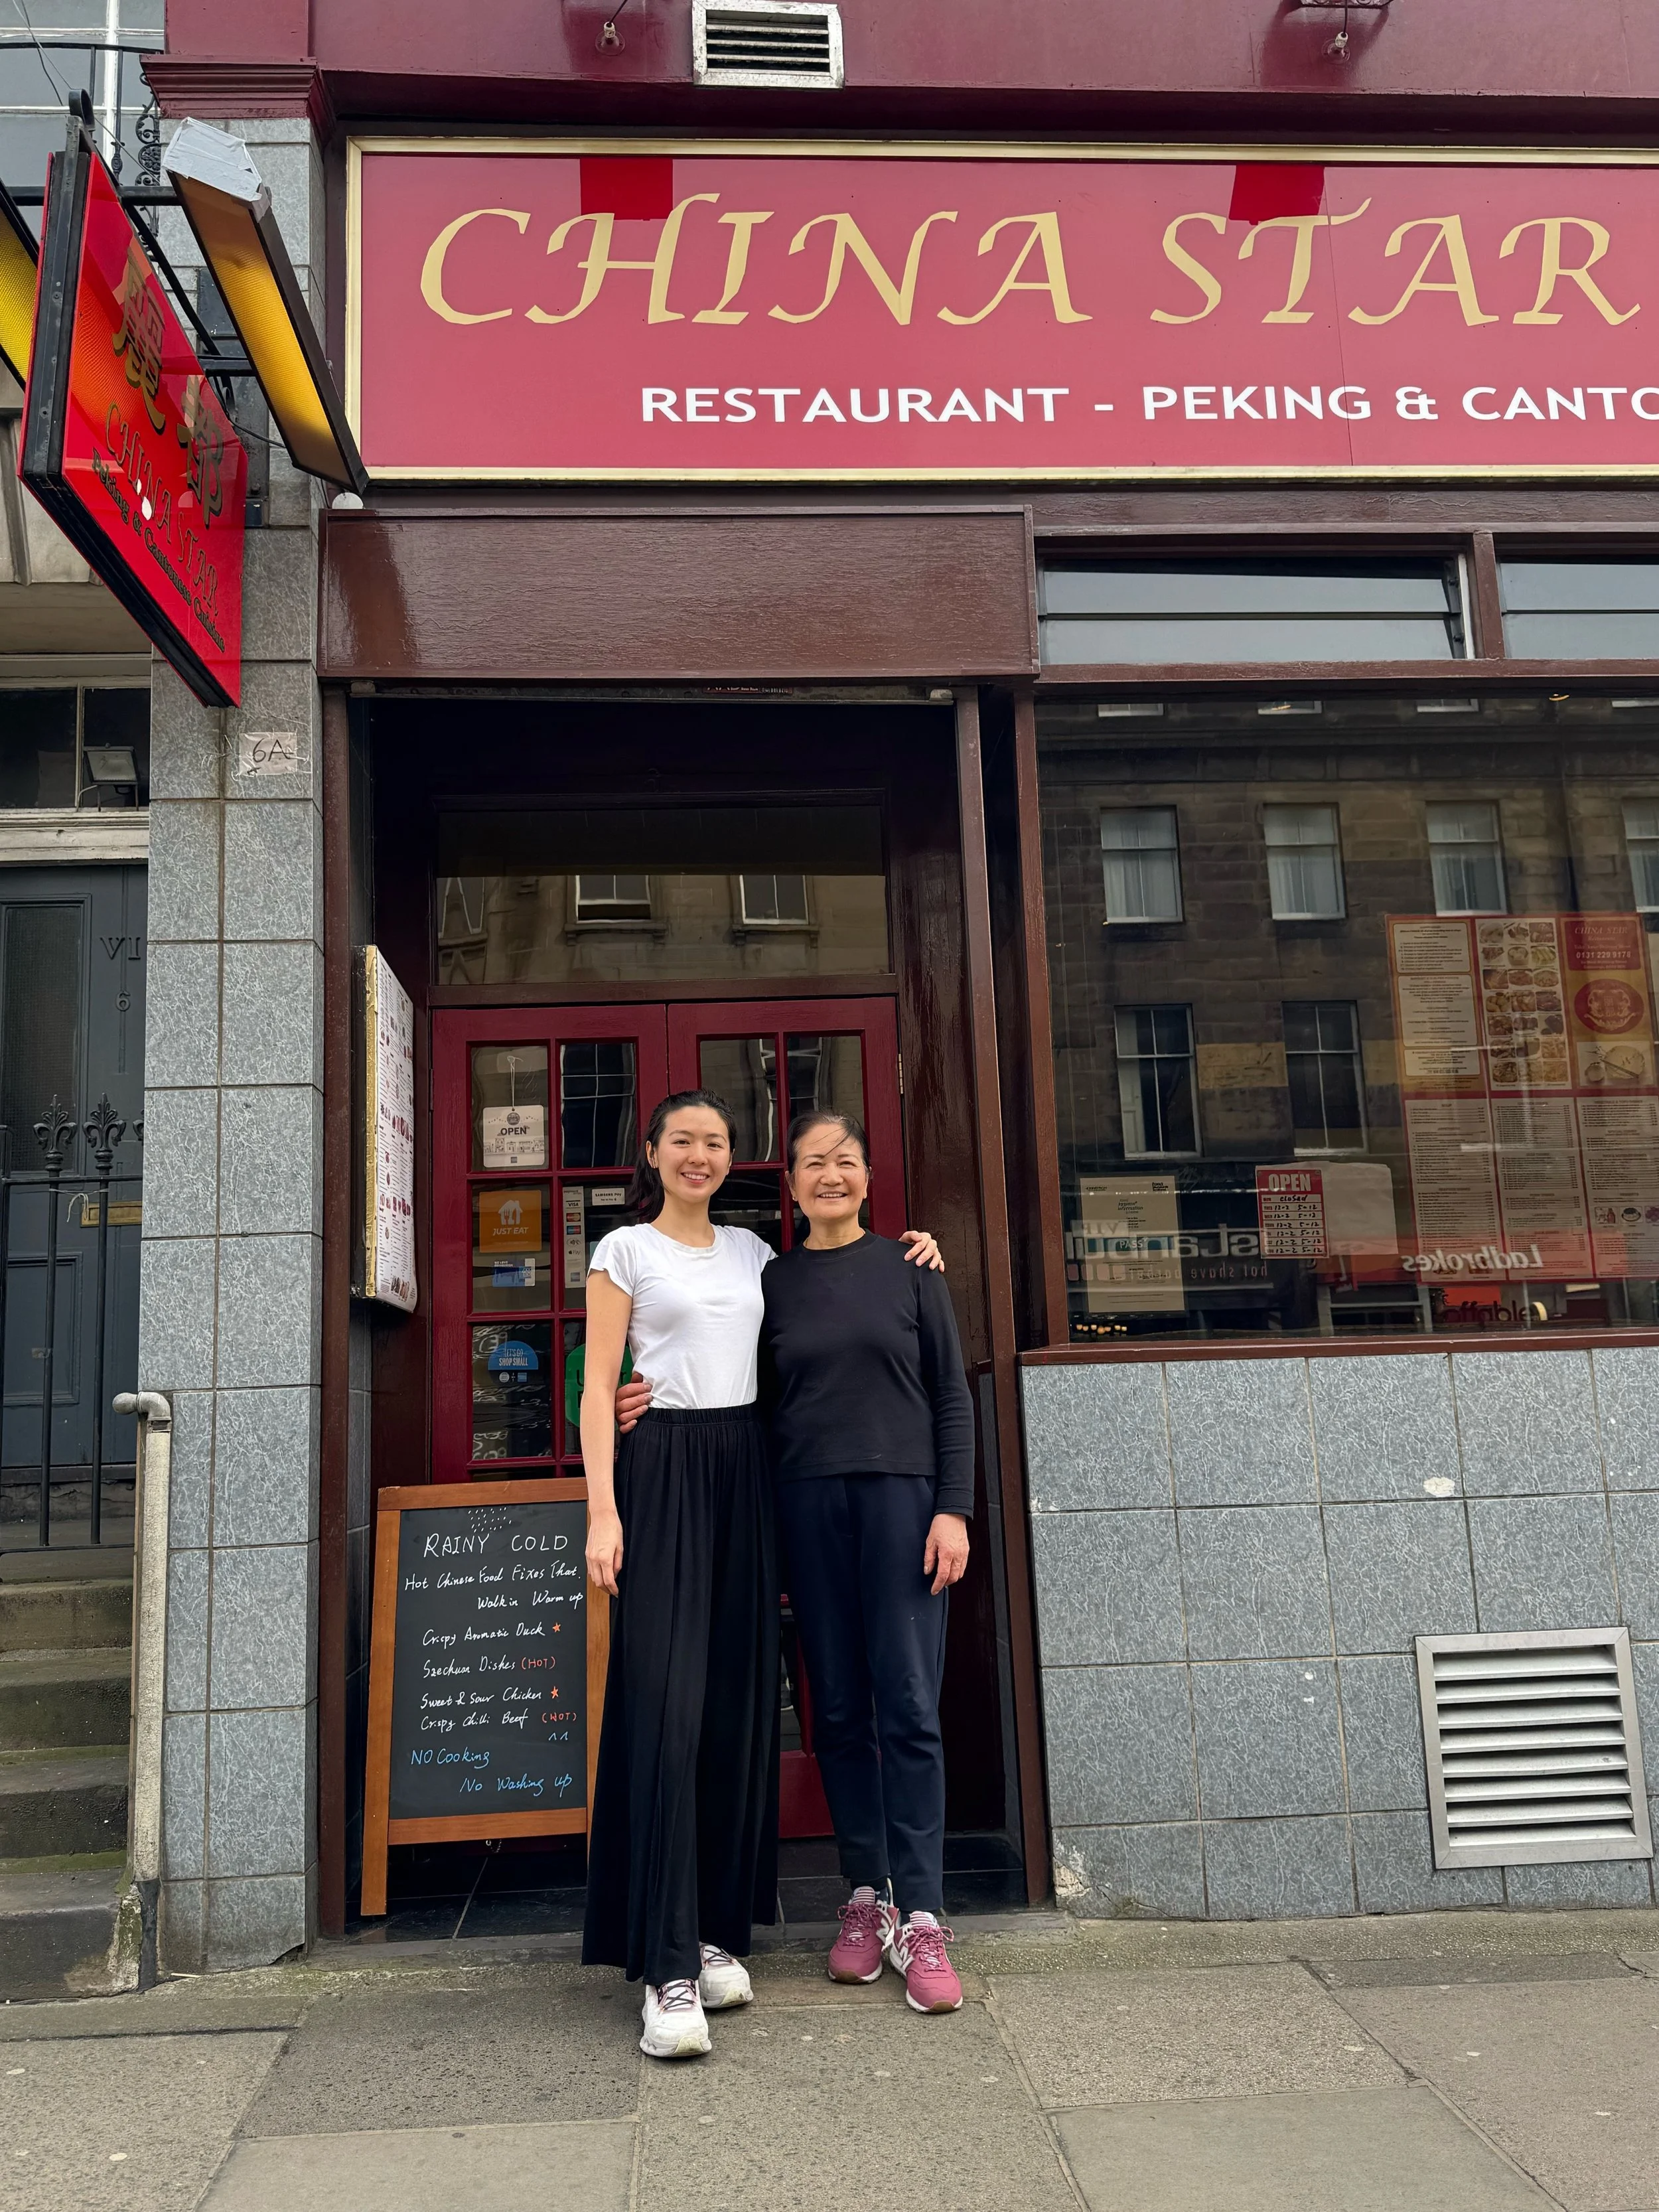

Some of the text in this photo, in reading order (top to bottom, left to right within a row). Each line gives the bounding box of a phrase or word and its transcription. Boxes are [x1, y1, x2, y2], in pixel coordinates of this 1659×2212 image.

[420, 192, 1641, 327] CHINA STAR
[641, 388, 1069, 423] RESTAURANT
[1143, 386, 1372, 421] PEKING
[1396, 386, 1438, 420] &
[106, 400, 219, 617] CHINA STAR
[92, 447, 225, 652] Peking & Cantonese Cuisine
[253, 738, 294, 763] 6A
[100, 936, 141, 960] VI
[115, 993, 131, 1012] 6
[500, 1126, 527, 1136] OPEN
[1268, 1173, 1311, 1191] OPEN
[499, 1357, 528, 1366] SHOP SMALL
[577, 1369, 626, 1387] Ur
[423, 1533, 568, 1558] RAINY COLD
[405, 1574, 429, 1591] Hot
[437, 1572, 474, 1589] Chinese
[479, 1566, 504, 1583] Food
[512, 1564, 545, 1582] Fixes
[532, 1590, 563, 1606] Warm
[569, 1592, 583, 1609] up
[423, 1621, 545, 1649] Crispy Aromatic Duck
[423, 1659, 470, 1678] Szechuan
[479, 1654, 516, 1672] Dishes
[420, 1687, 541, 1710] Sweet & Sour Chicken
[421, 1716, 456, 1733] Crispy
[502, 1708, 528, 1730] Beef
[411, 1747, 490, 1769] NO Cooking
[460, 1778, 482, 1793] No
[498, 1773, 544, 1797] Washing
